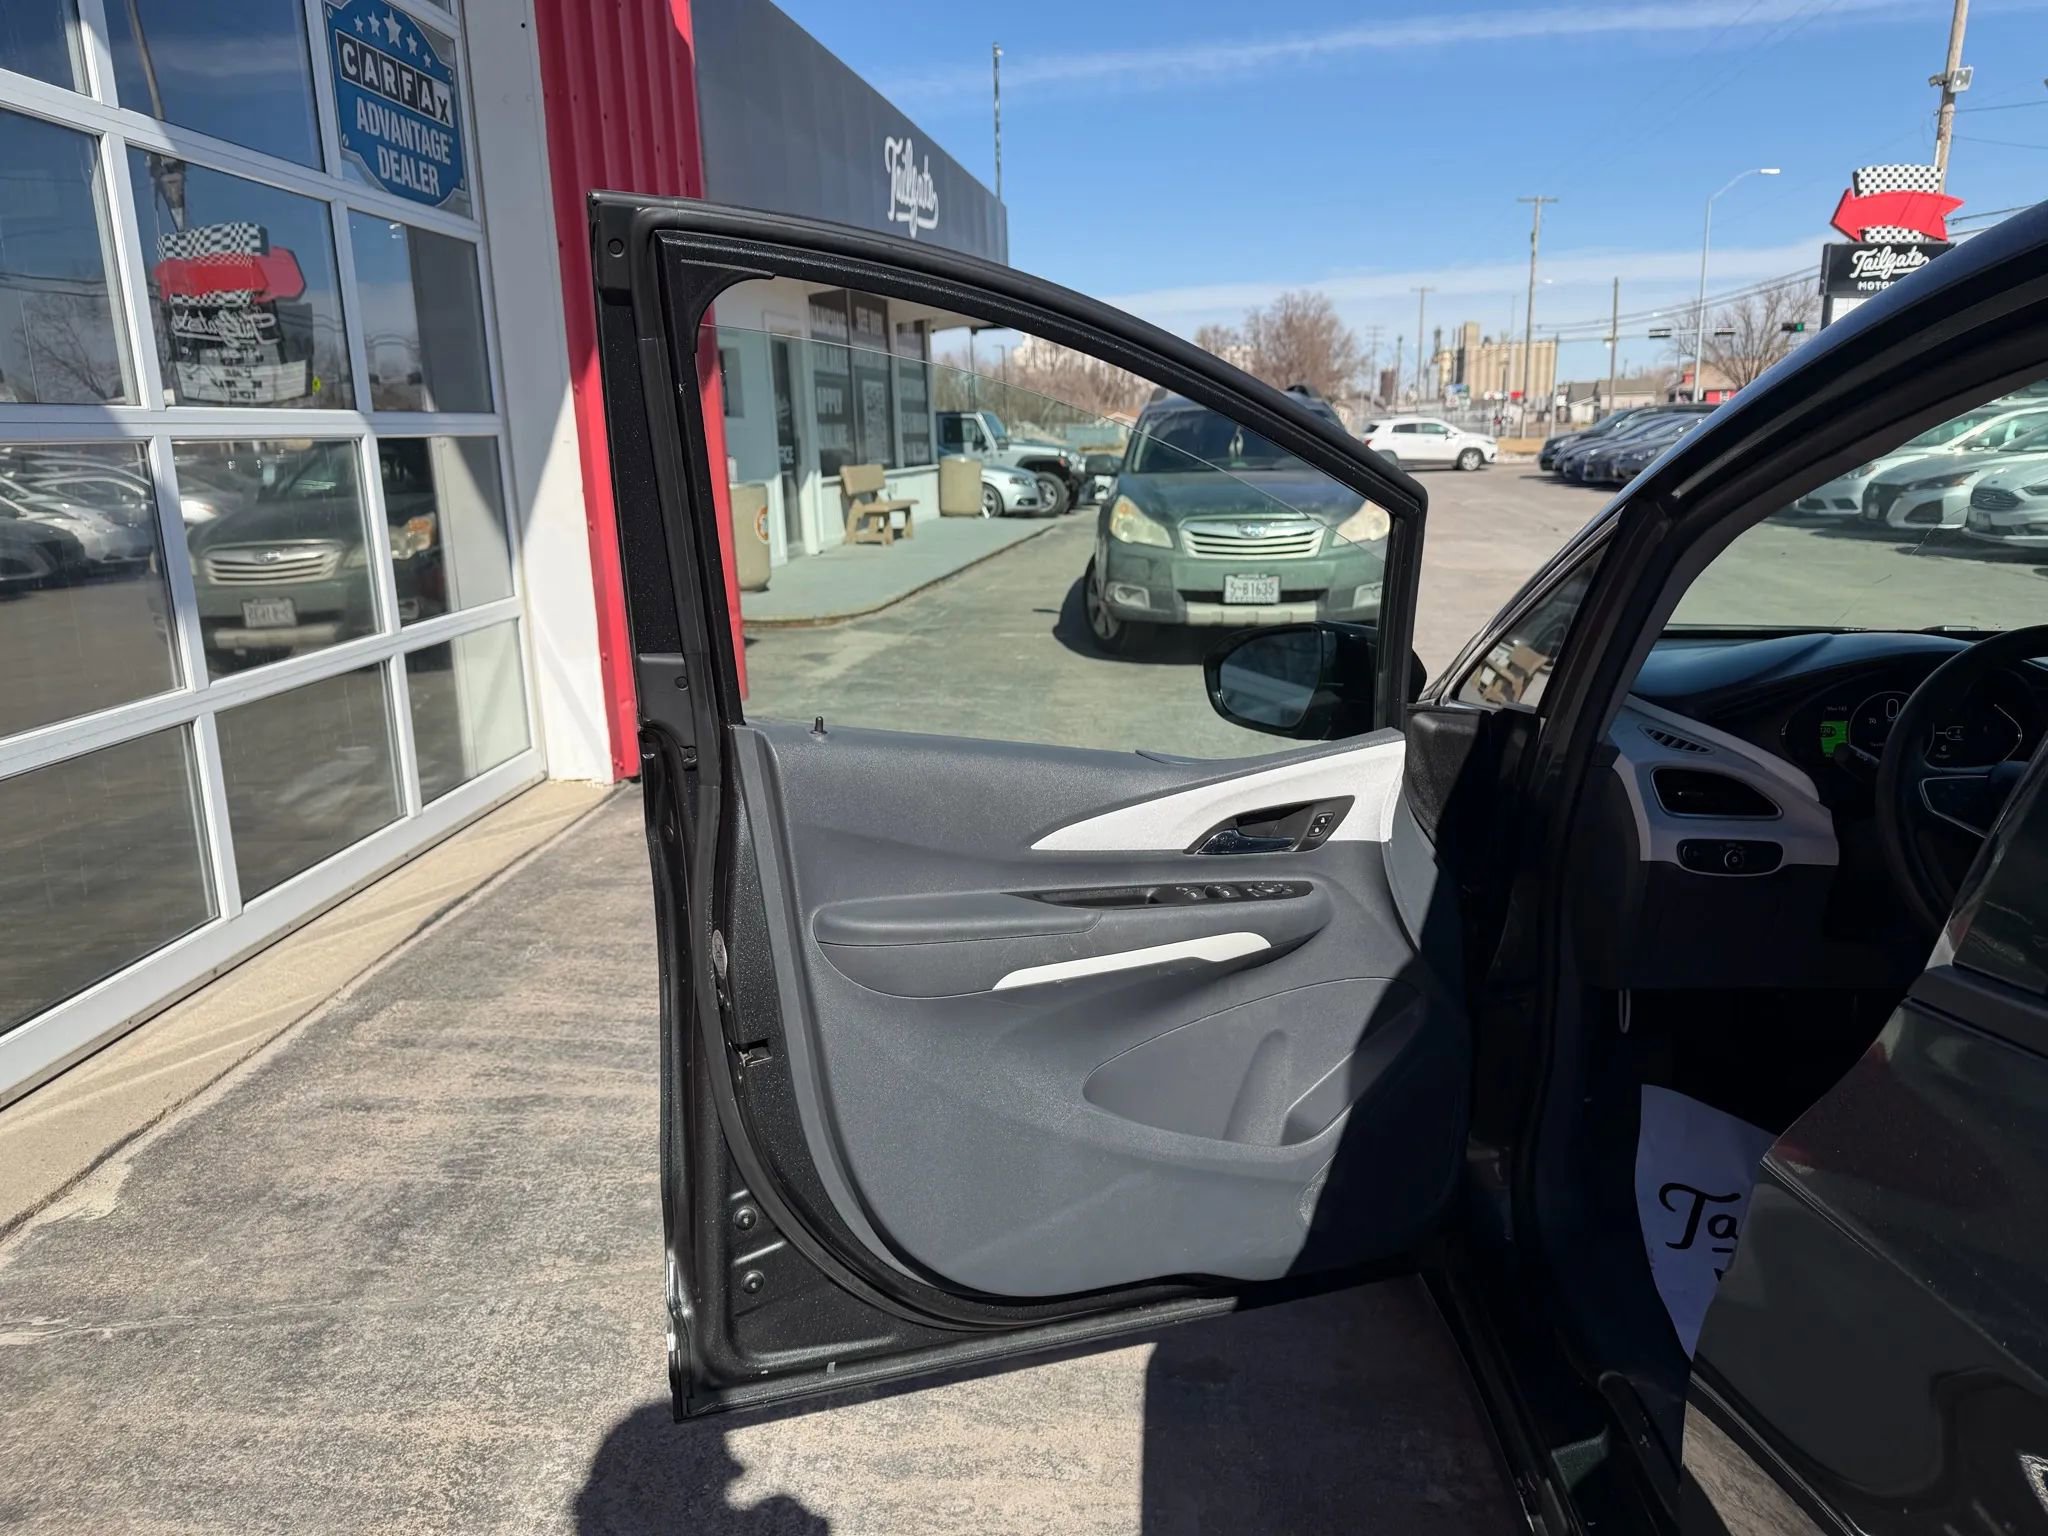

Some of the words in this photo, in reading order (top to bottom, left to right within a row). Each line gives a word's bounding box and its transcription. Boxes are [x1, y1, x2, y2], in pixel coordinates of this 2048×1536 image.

[342, 42, 449, 125] CARFAX
[356, 96, 451, 165] ADVANTAGE
[377, 144, 440, 197] DEALER
[1849, 245, 1930, 280] Tailgate
